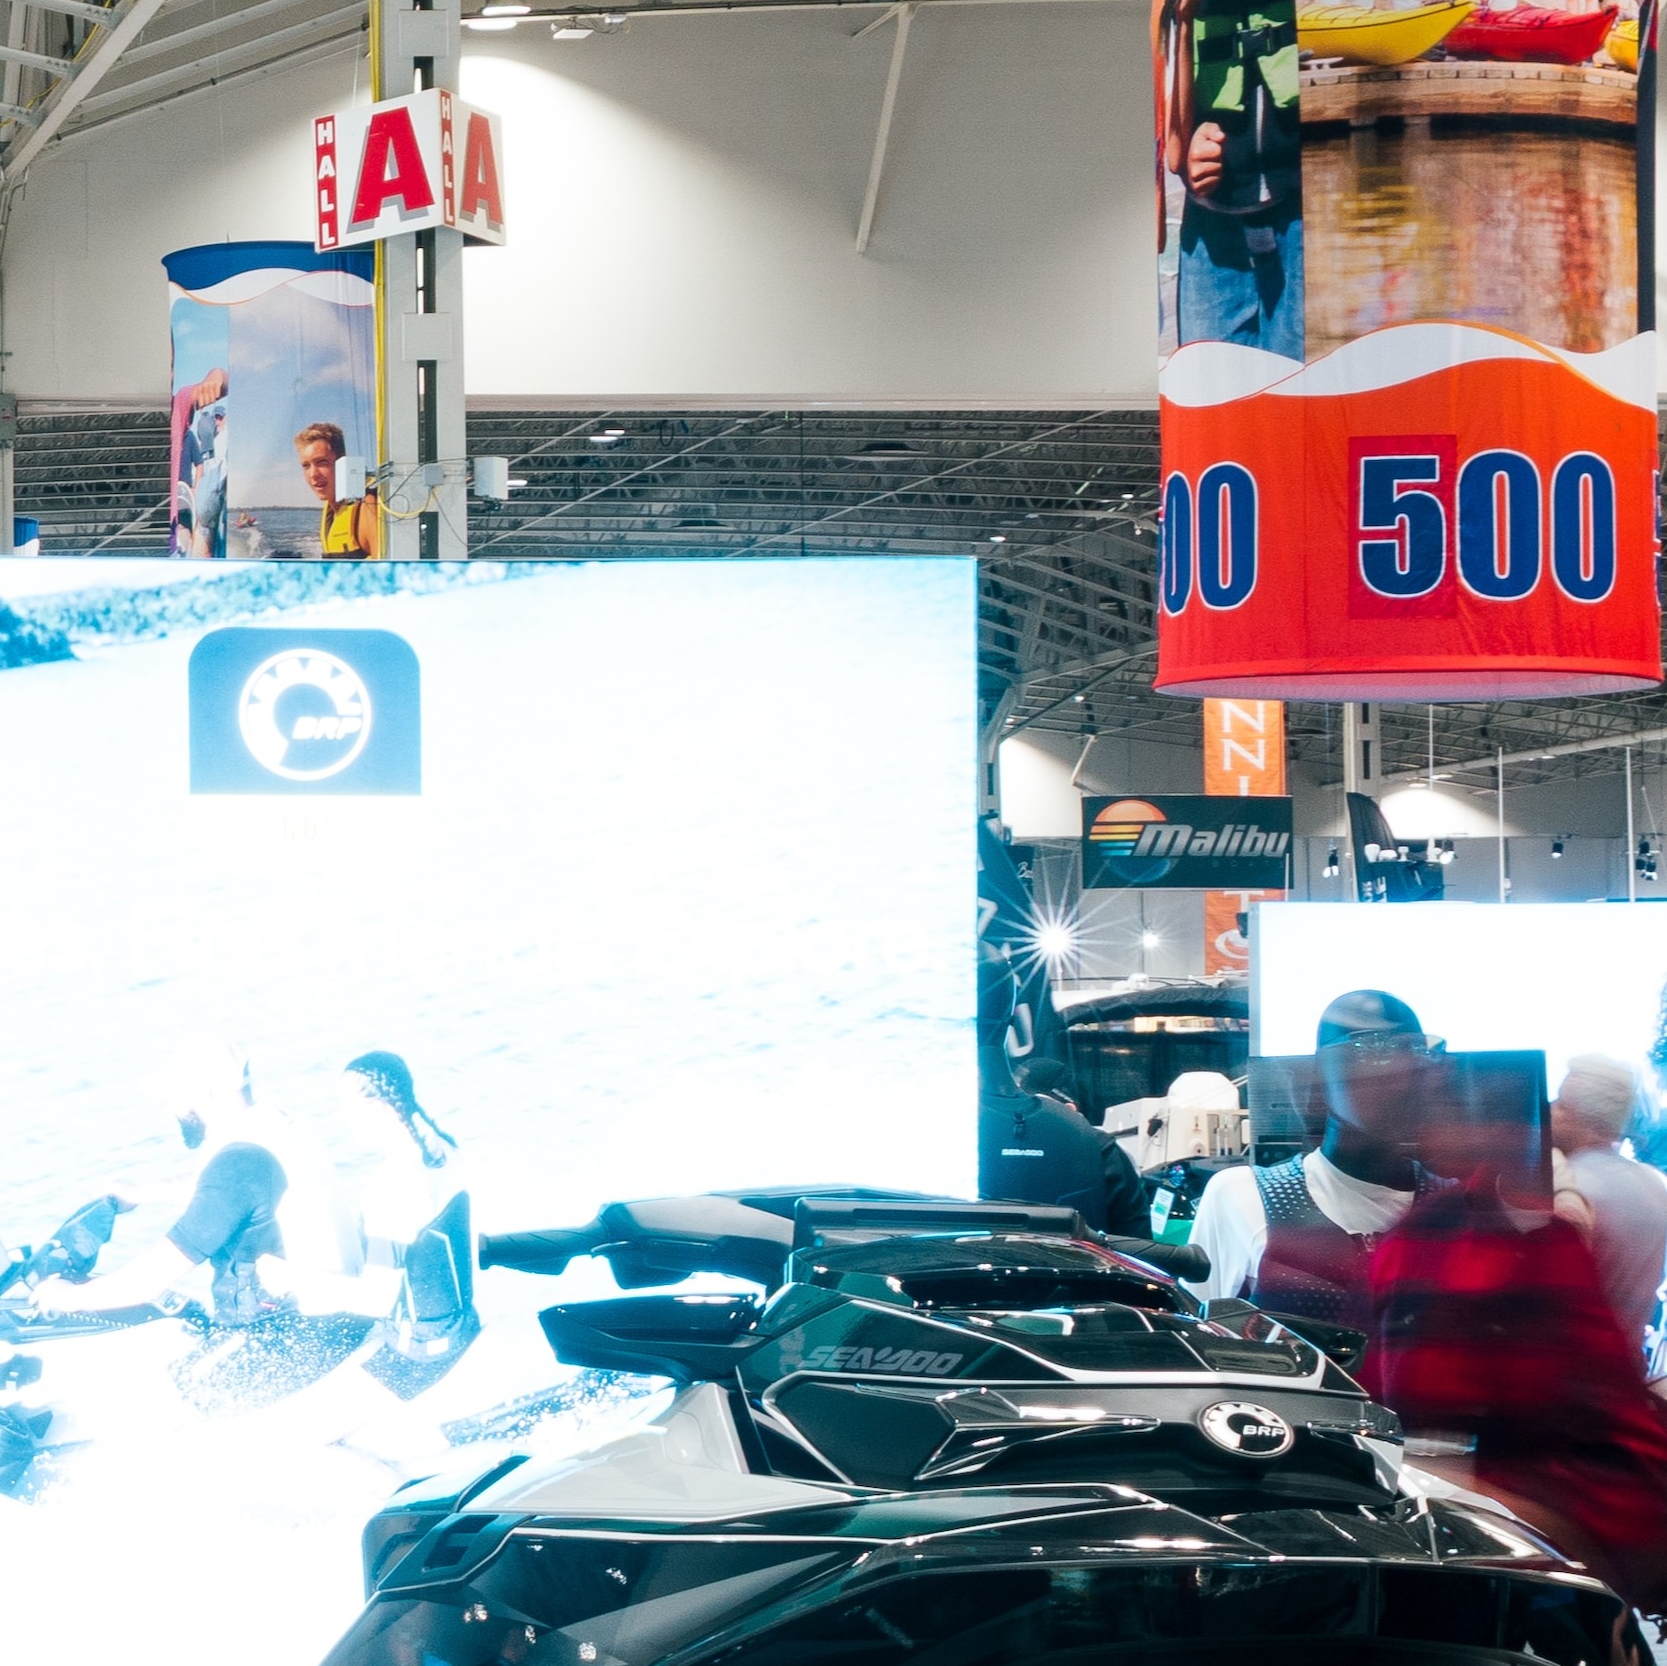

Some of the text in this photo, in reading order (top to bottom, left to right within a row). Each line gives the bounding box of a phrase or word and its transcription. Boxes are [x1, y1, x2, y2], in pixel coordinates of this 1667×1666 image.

[317, 120, 336, 246] HALL
[347, 106, 436, 233] A
[459, 112, 504, 232] A
[1358, 449, 1616, 604] 500
[291, 716, 362, 741] BRP
[1133, 824, 1290, 858] Malibu
[1242, 1424, 1285, 1437] BRP
